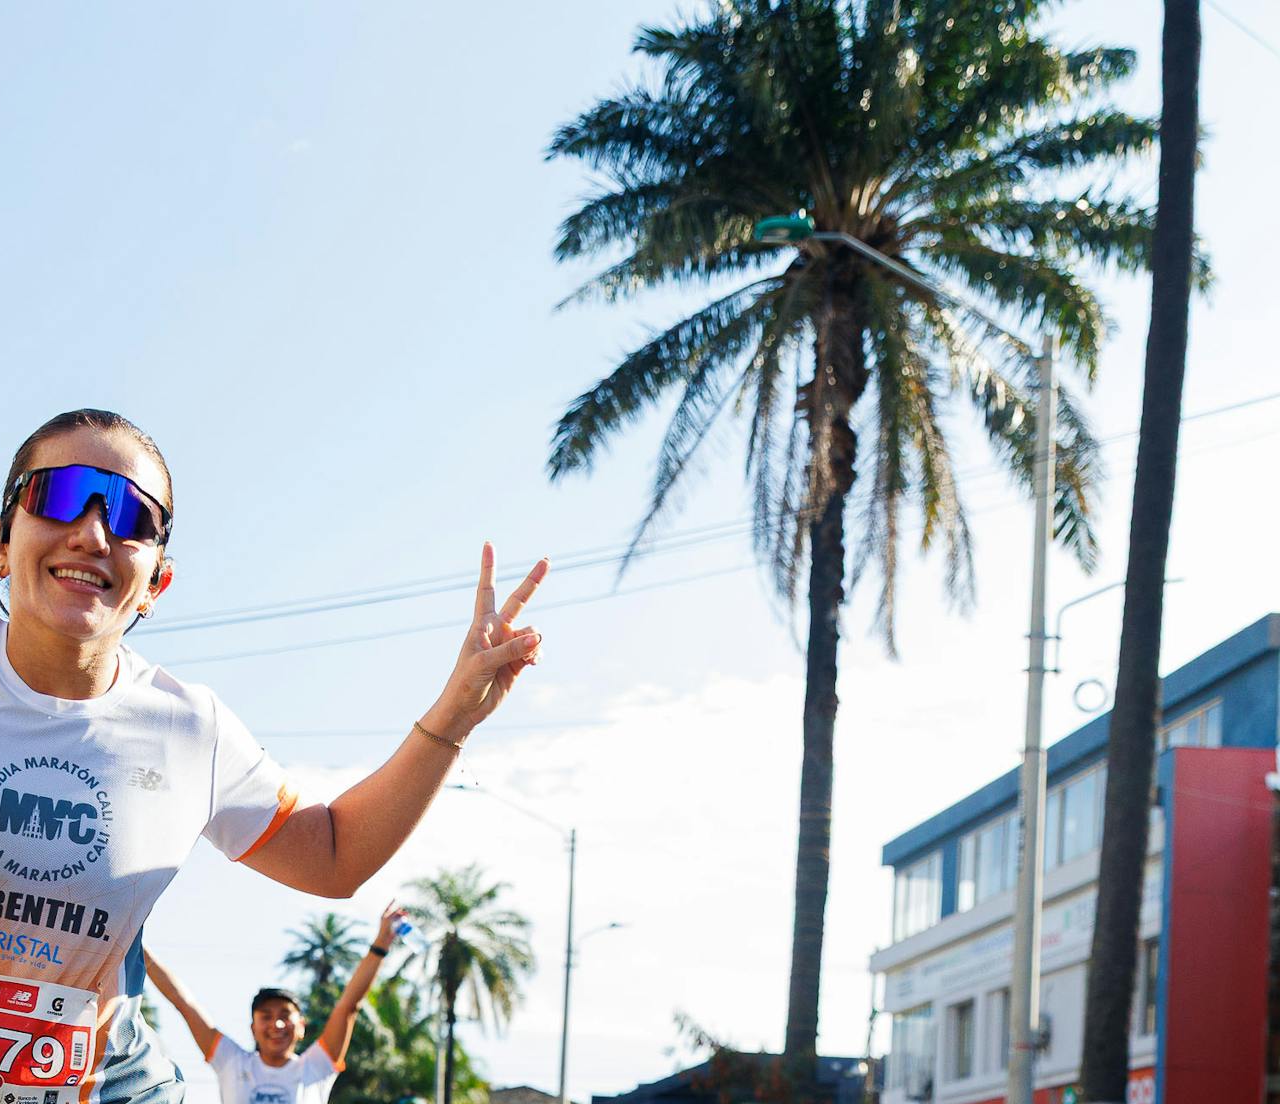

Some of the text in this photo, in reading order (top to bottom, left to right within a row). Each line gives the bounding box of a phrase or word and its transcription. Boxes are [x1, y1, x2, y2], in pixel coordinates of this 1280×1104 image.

[24, 756, 100, 790] MARATÓN
[96, 790, 113, 822] CALI
[4, 859, 86, 882] MARATÓN
[86, 831, 111, 863] CALI
[87, 907, 111, 942] B.
